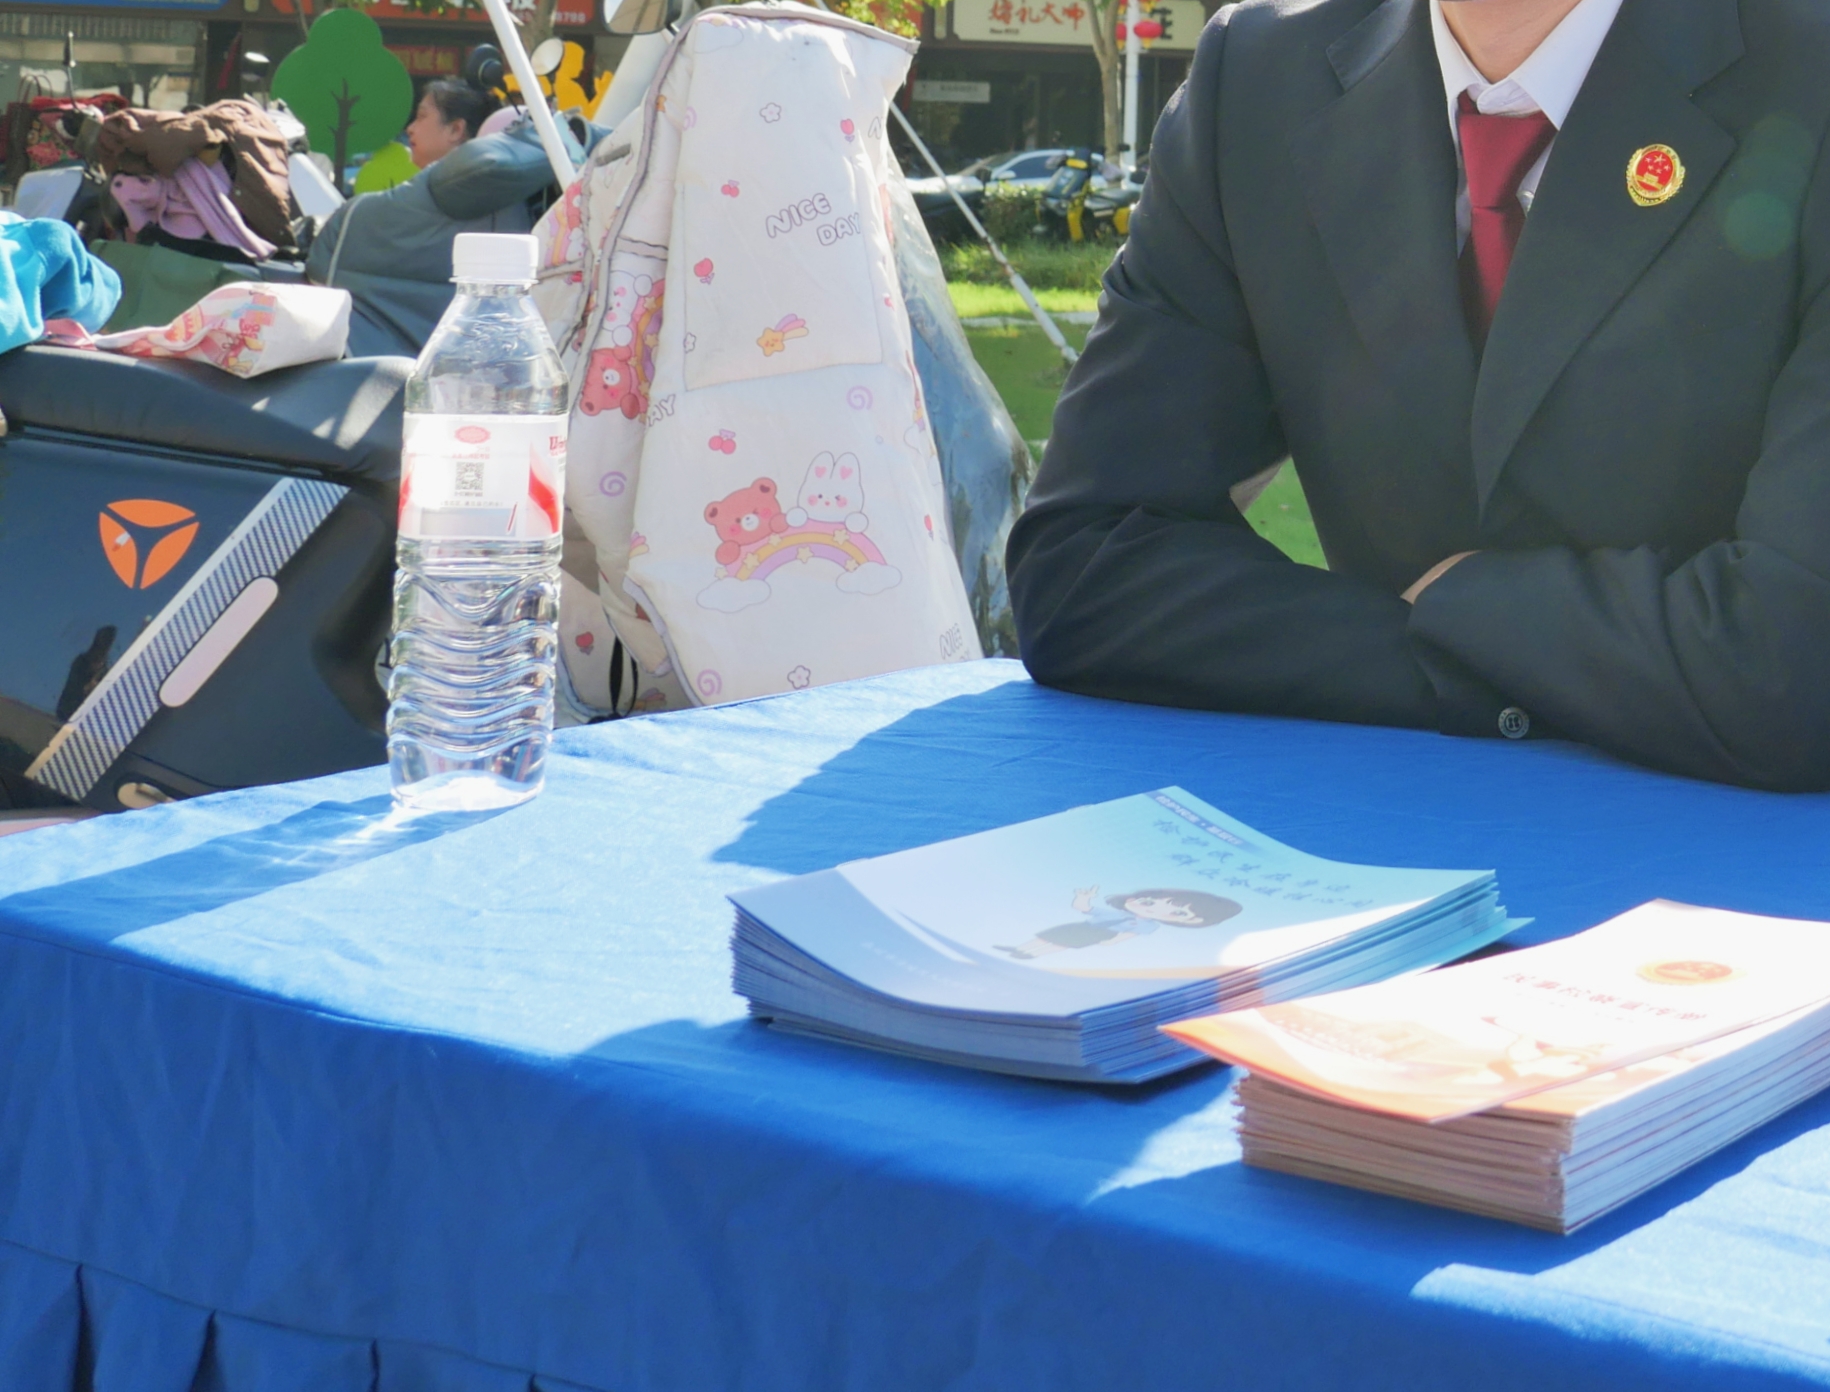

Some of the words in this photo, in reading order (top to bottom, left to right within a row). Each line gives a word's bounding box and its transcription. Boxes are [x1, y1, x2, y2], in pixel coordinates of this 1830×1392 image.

[766, 193, 832, 239] NICE
[816, 212, 861, 246] DAY
[648, 393, 676, 427] AY
